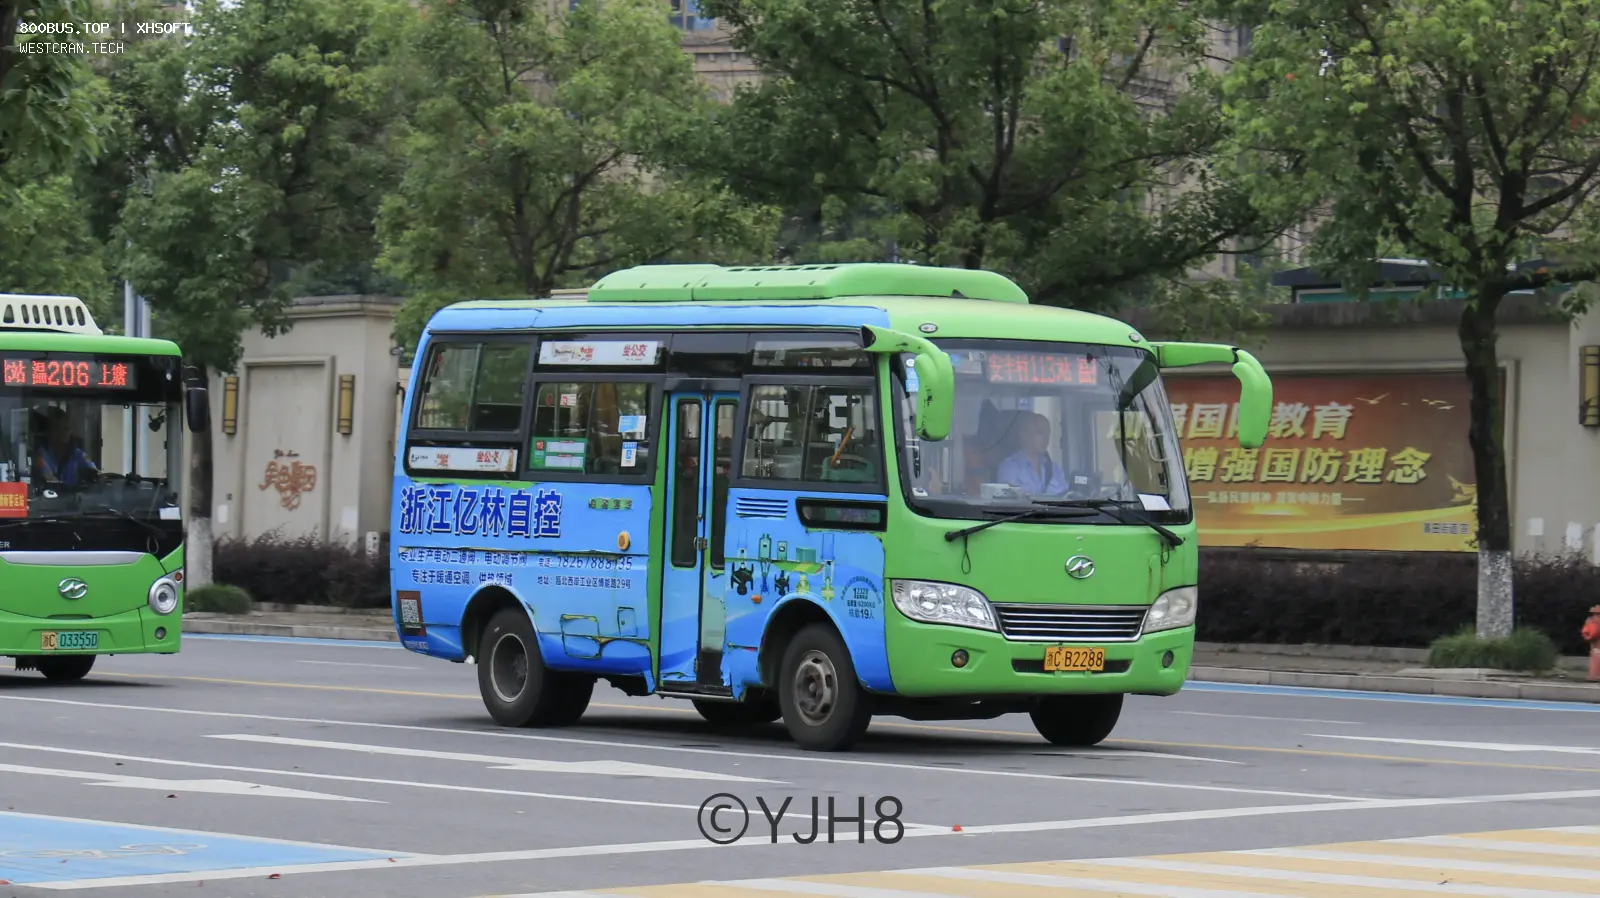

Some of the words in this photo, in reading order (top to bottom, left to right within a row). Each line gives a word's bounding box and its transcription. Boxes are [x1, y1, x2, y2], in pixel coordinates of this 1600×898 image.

[1184, 446, 1433, 484] 增强国防理念
[400, 485, 562, 538] 浙江亿林自控
